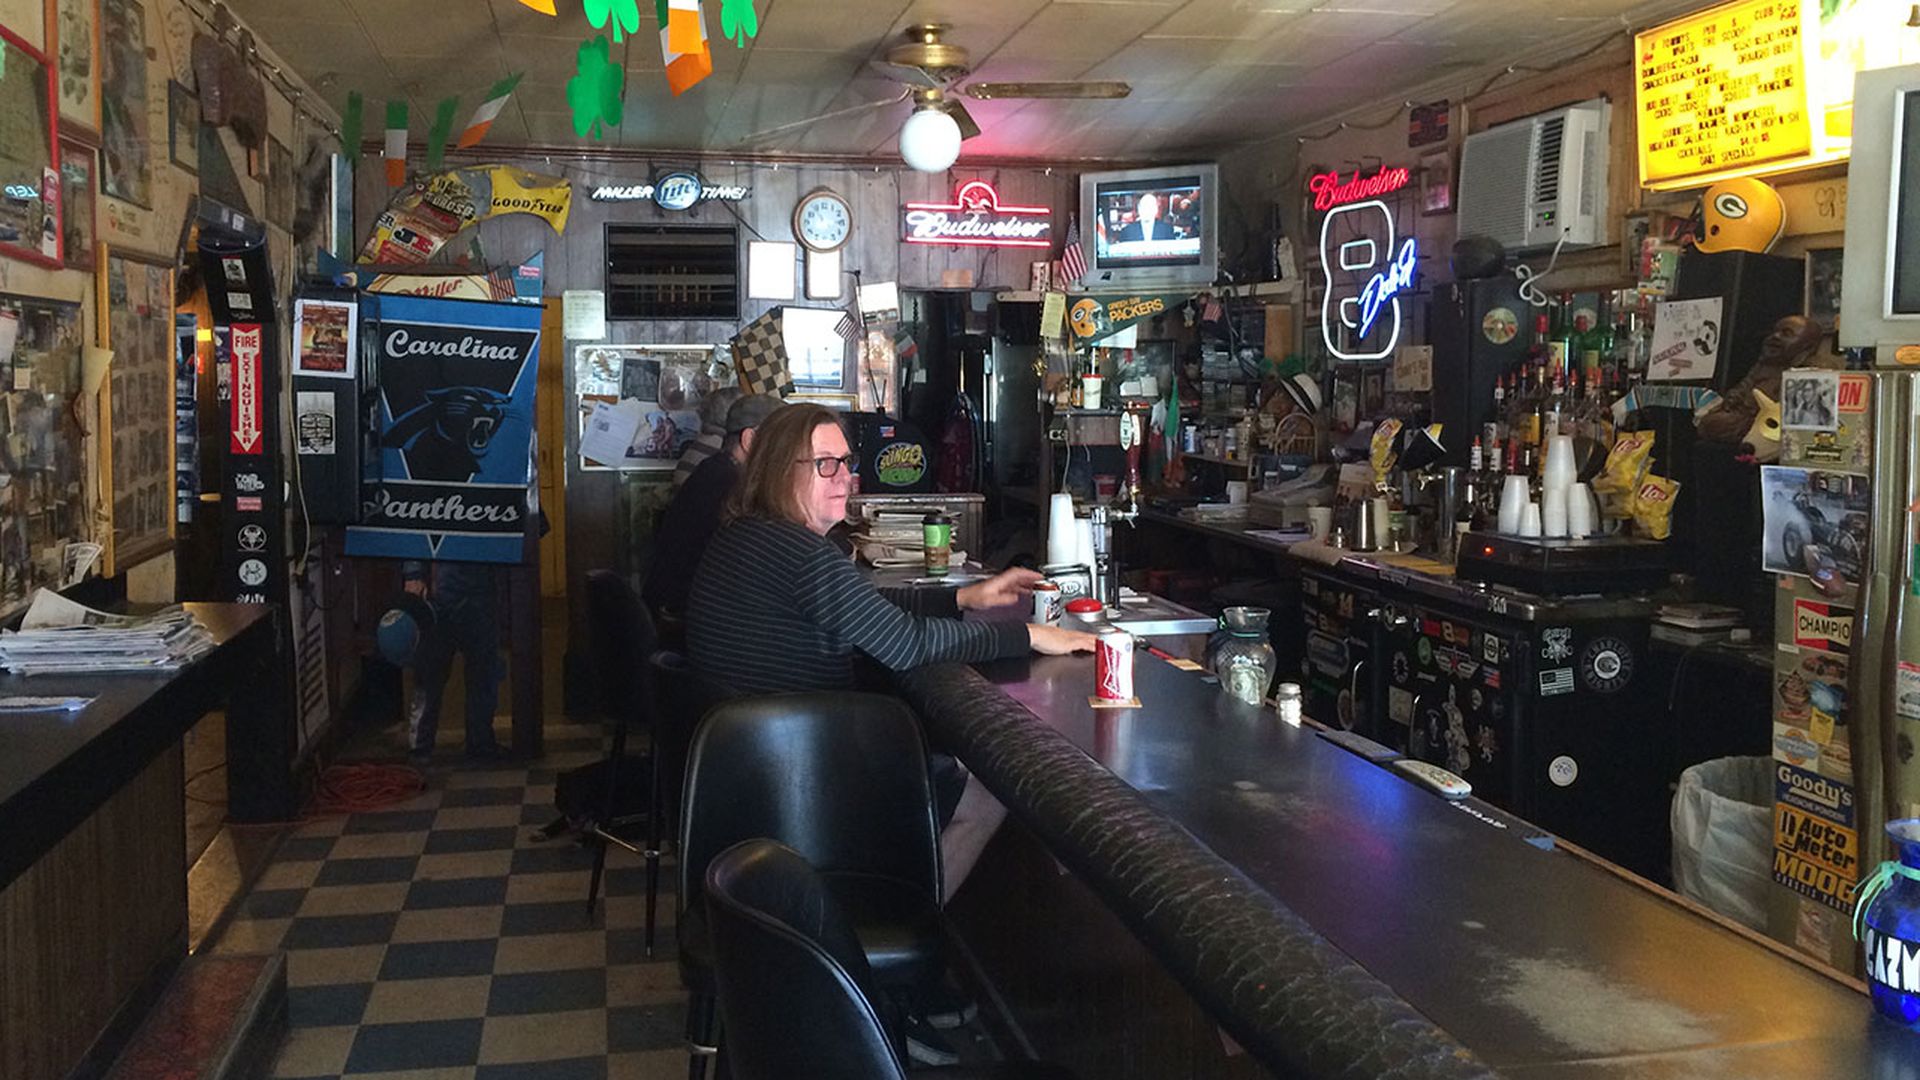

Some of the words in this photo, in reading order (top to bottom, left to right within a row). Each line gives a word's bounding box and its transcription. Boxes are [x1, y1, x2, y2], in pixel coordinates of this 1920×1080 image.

[592, 185, 655, 200] MILLER
[700, 186, 747, 200] TIME!
[1309, 164, 1409, 211] Budweiser
[492, 196, 564, 216] GOODYEAR
[905, 210, 1050, 238] Budweiser
[1320, 200, 1400, 360] 8
[1109, 298, 1164, 322] PACKERS
[235, 335, 257, 348] FIRE
[385, 329, 519, 360] Carolina
[242, 352, 252, 444] EXTINGUISHER
[1777, 765, 1853, 807] Goody's
[1799, 816, 1848, 849] Auto
[1794, 832, 1856, 869] Meter
[1774, 850, 1857, 905] MOOG
